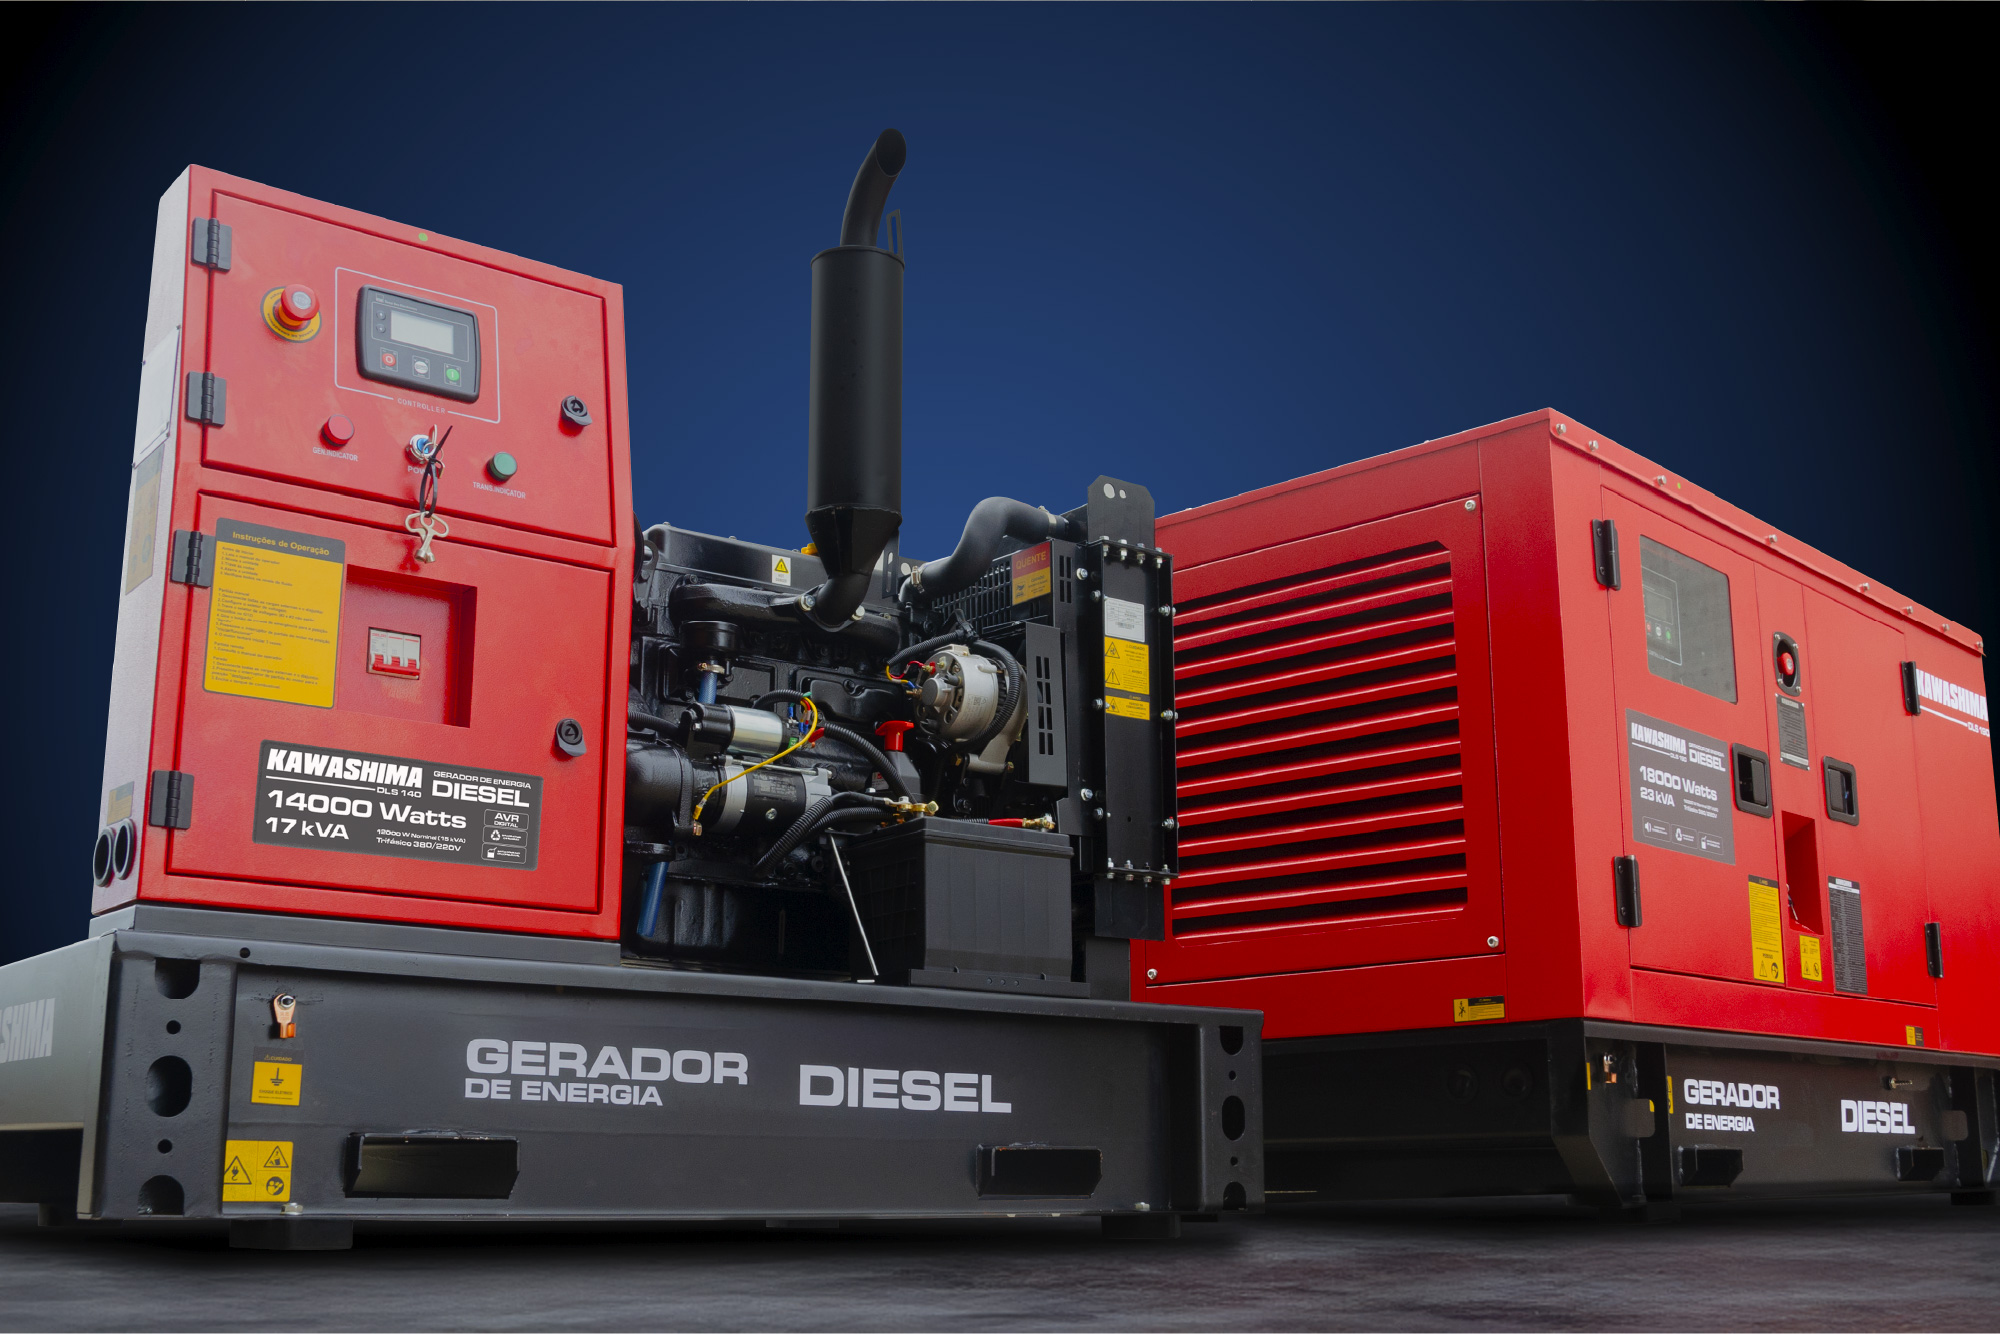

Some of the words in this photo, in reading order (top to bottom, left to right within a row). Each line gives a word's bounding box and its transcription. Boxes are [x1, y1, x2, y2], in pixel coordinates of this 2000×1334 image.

[397, 398, 446, 414] CONTROLLER
[312, 447, 358, 462] GEN.INDICATOR
[473, 481, 526, 499] TRANS.INDICATOR
[232, 531, 276, 546] Instruções
[278, 540, 288, 548] de
[290, 541, 330, 556] Operação
[1015, 551, 1047, 570] QUENTE
[1915, 668, 1989, 722] KAWASHIMA
[1631, 722, 1687, 755] KAWASHIMA
[266, 748, 423, 789] KAWASHIMA
[1688, 749, 1726, 772] DIESEL
[377, 786, 399, 796] DLS
[401, 789, 422, 798] 140
[433, 770, 479, 783] GERADOR
[480, 776, 492, 784] DE
[493, 778, 531, 790] ENERGIA
[1639, 765, 1681, 790] 18000
[1682, 777, 1718, 802] Watts
[431, 779, 530, 808] DIESEL
[1640, 787, 1654, 801] 23
[1655, 788, 1675, 807] kVA
[267, 789, 373, 818] 14000
[379, 801, 467, 829] Watts
[494, 812, 520, 823] AVR
[265, 816, 297, 834] 17
[301, 820, 350, 840] kVA
[493, 820, 519, 828] DIGITAL
[376, 836, 412, 847] Trifásico
[413, 840, 462, 852] 380/220V
[410, 832, 437, 841] Nominal
[0, 997, 55, 1064] SHIMA
[466, 1038, 749, 1085] GERADOR
[465, 1078, 511, 1100] DE
[521, 1080, 663, 1106] ENERGIA
[799, 1064, 1012, 1114] DIESEL
[1684, 1078, 1780, 1110] GERADOR
[1685, 1112, 1703, 1130] DE
[1703, 1113, 1755, 1132] ENERGIA
[1841, 1099, 1915, 1134] DIESEL
